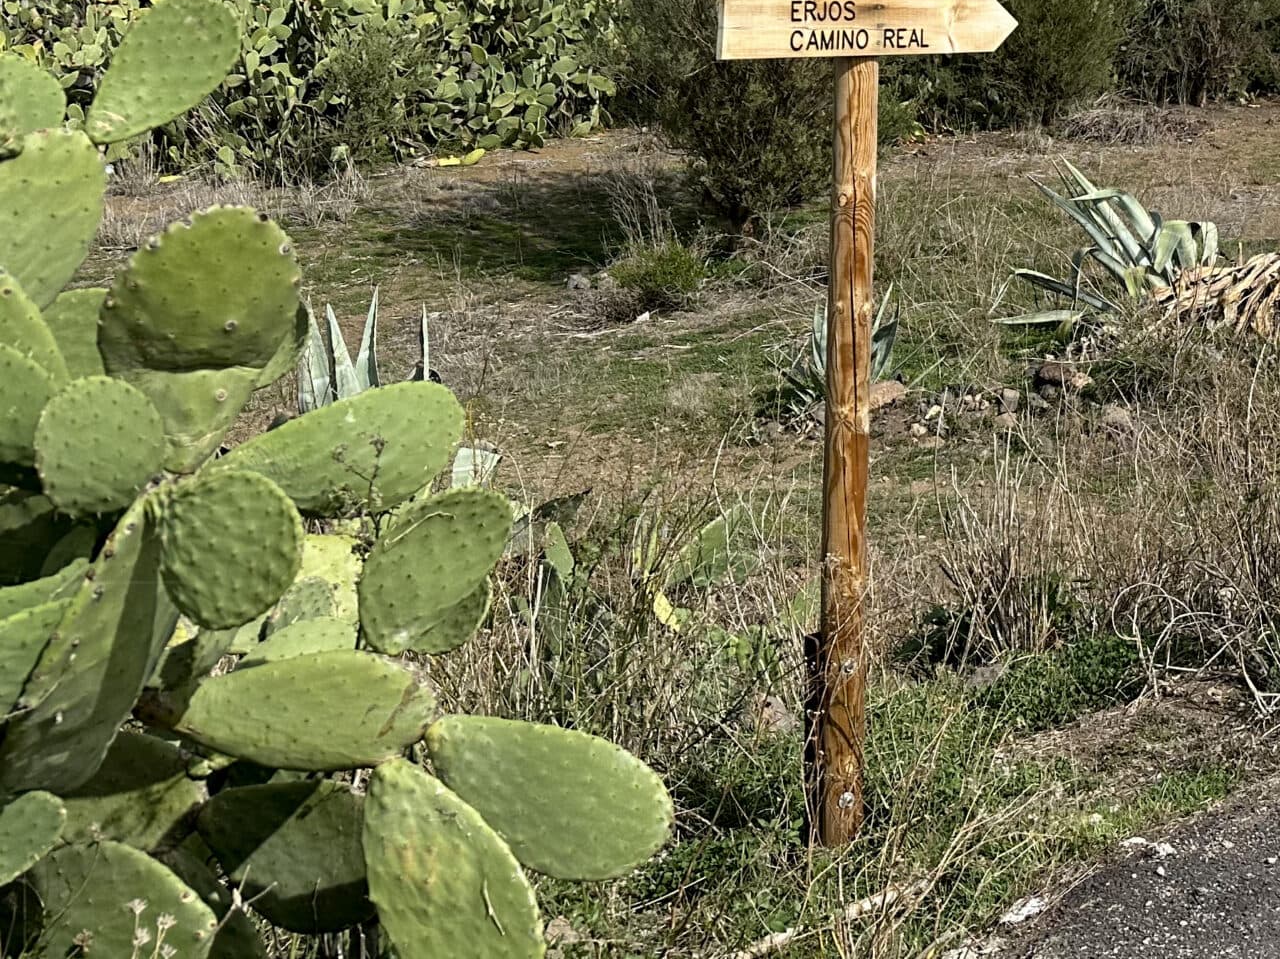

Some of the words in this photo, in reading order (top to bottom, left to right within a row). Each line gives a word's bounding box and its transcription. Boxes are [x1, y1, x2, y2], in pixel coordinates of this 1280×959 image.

[791, 1, 856, 22] ERJOS
[790, 29, 869, 51] CAMINO
[884, 28, 930, 48] REAL
